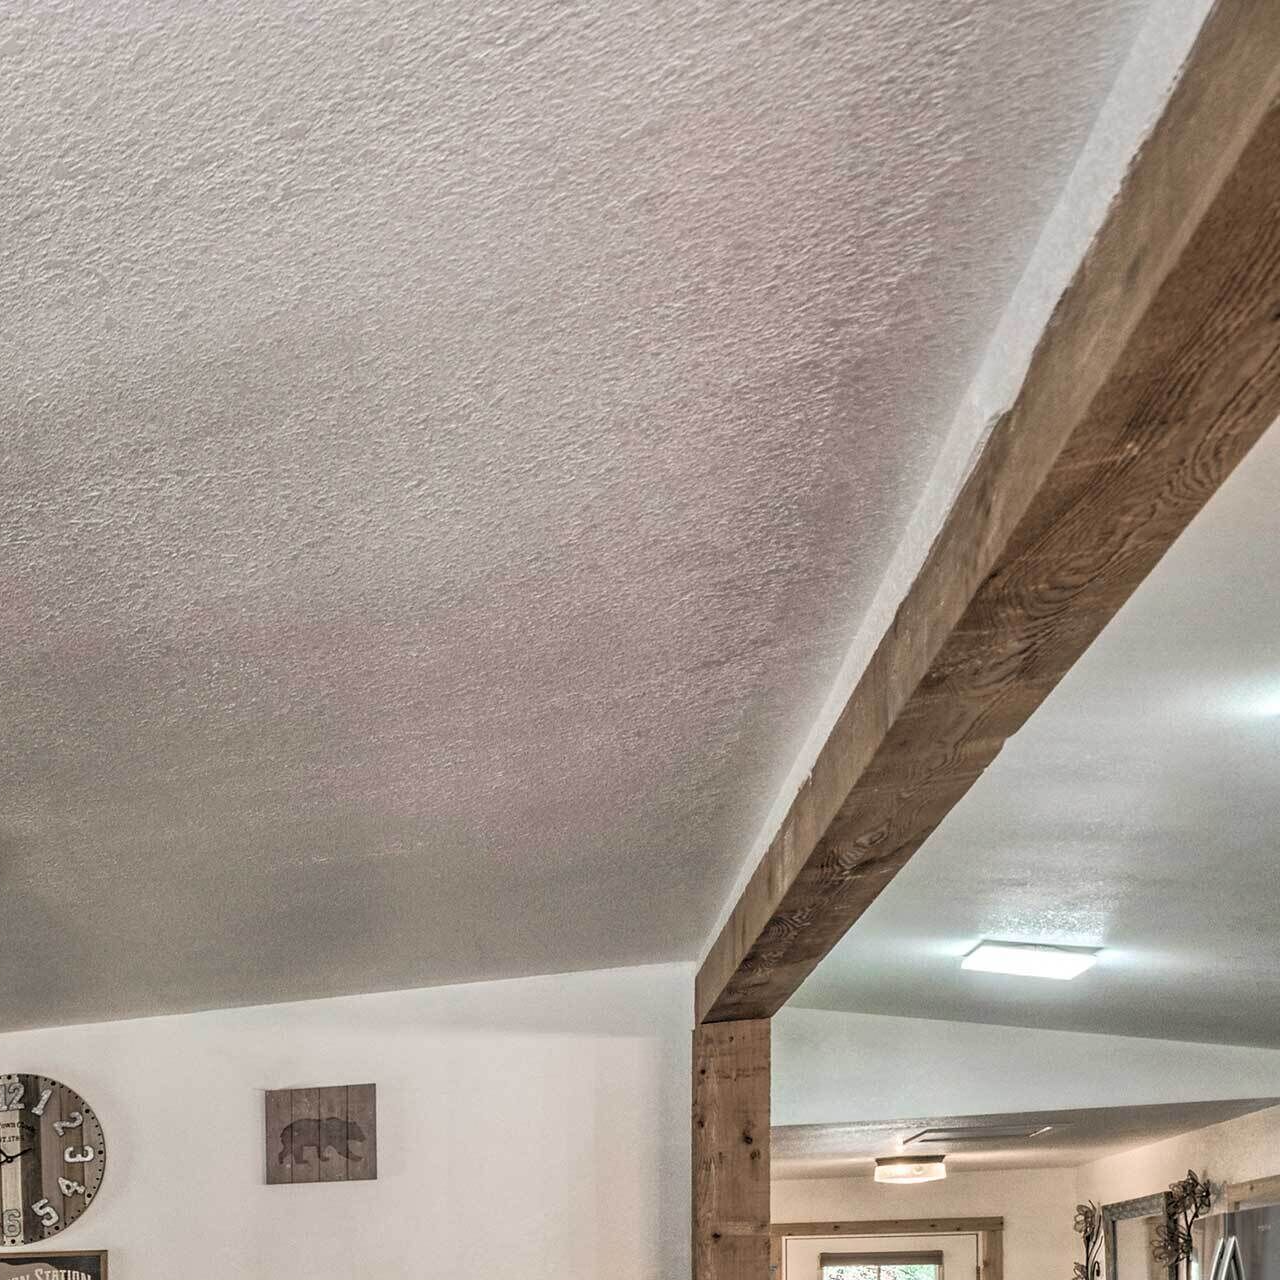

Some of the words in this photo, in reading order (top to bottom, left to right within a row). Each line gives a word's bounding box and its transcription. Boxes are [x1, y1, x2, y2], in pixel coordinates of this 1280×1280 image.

[31, 1088, 52, 1116] 1
[52, 1111, 83, 1137] 2
[64, 1144, 95, 1163] 3
[57, 1176, 86, 1198] 4
[2, 1208, 22, 1238] 6
[31, 1198, 59, 1227] 5
